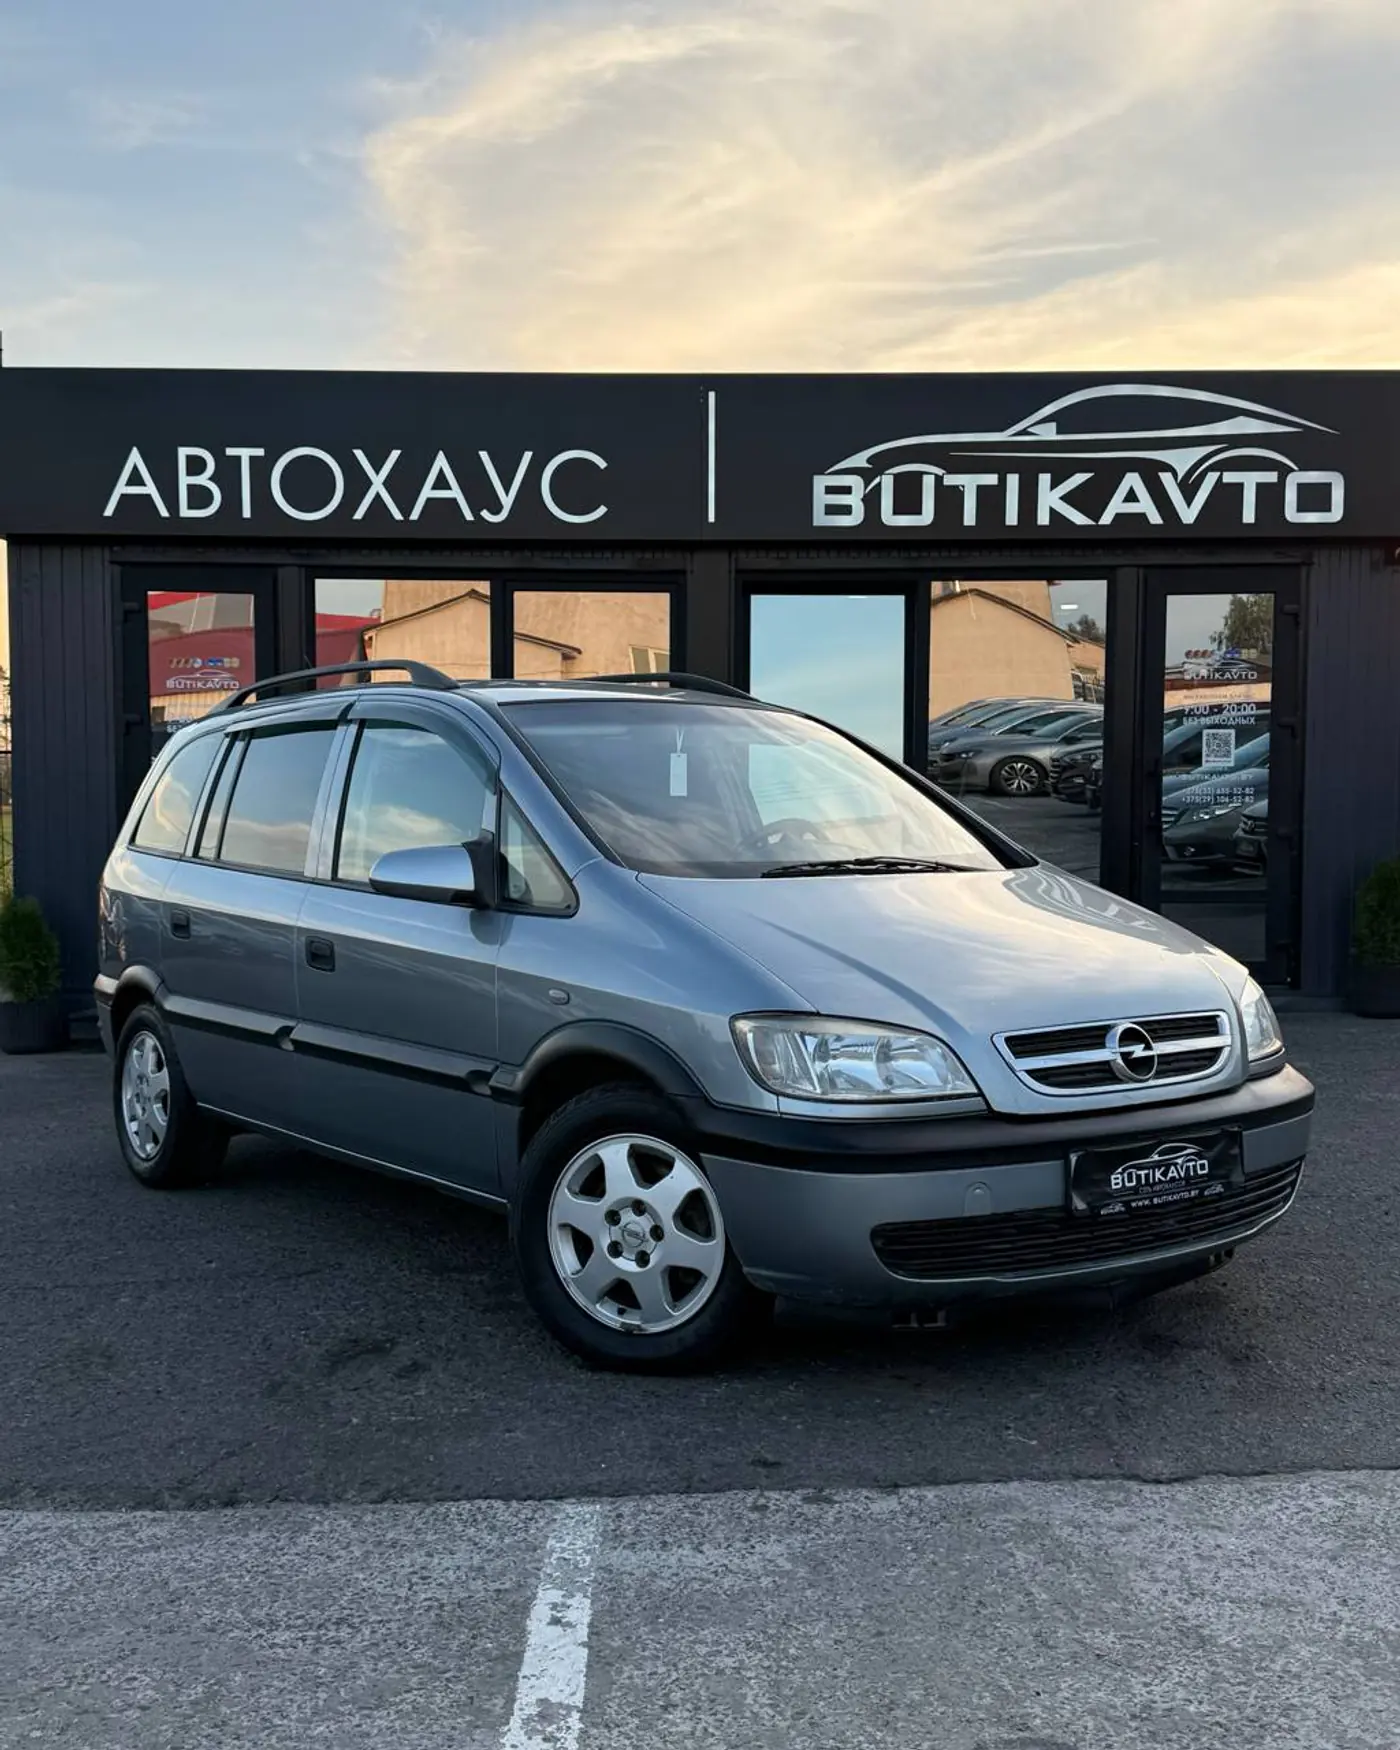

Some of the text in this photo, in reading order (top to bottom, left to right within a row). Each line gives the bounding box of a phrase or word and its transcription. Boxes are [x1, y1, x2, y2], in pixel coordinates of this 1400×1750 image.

[102, 445, 609, 524] АВТОХАУС
[812, 470, 1345, 528] BUTIKAVTO
[166, 679, 239, 689] BUTIKAVTO
[1222, 703, 1257, 715] 20:00
[1200, 716, 1256, 726] ВЫХОДНЫХ
[1110, 1159, 1209, 1189] BUTIKAVTO
